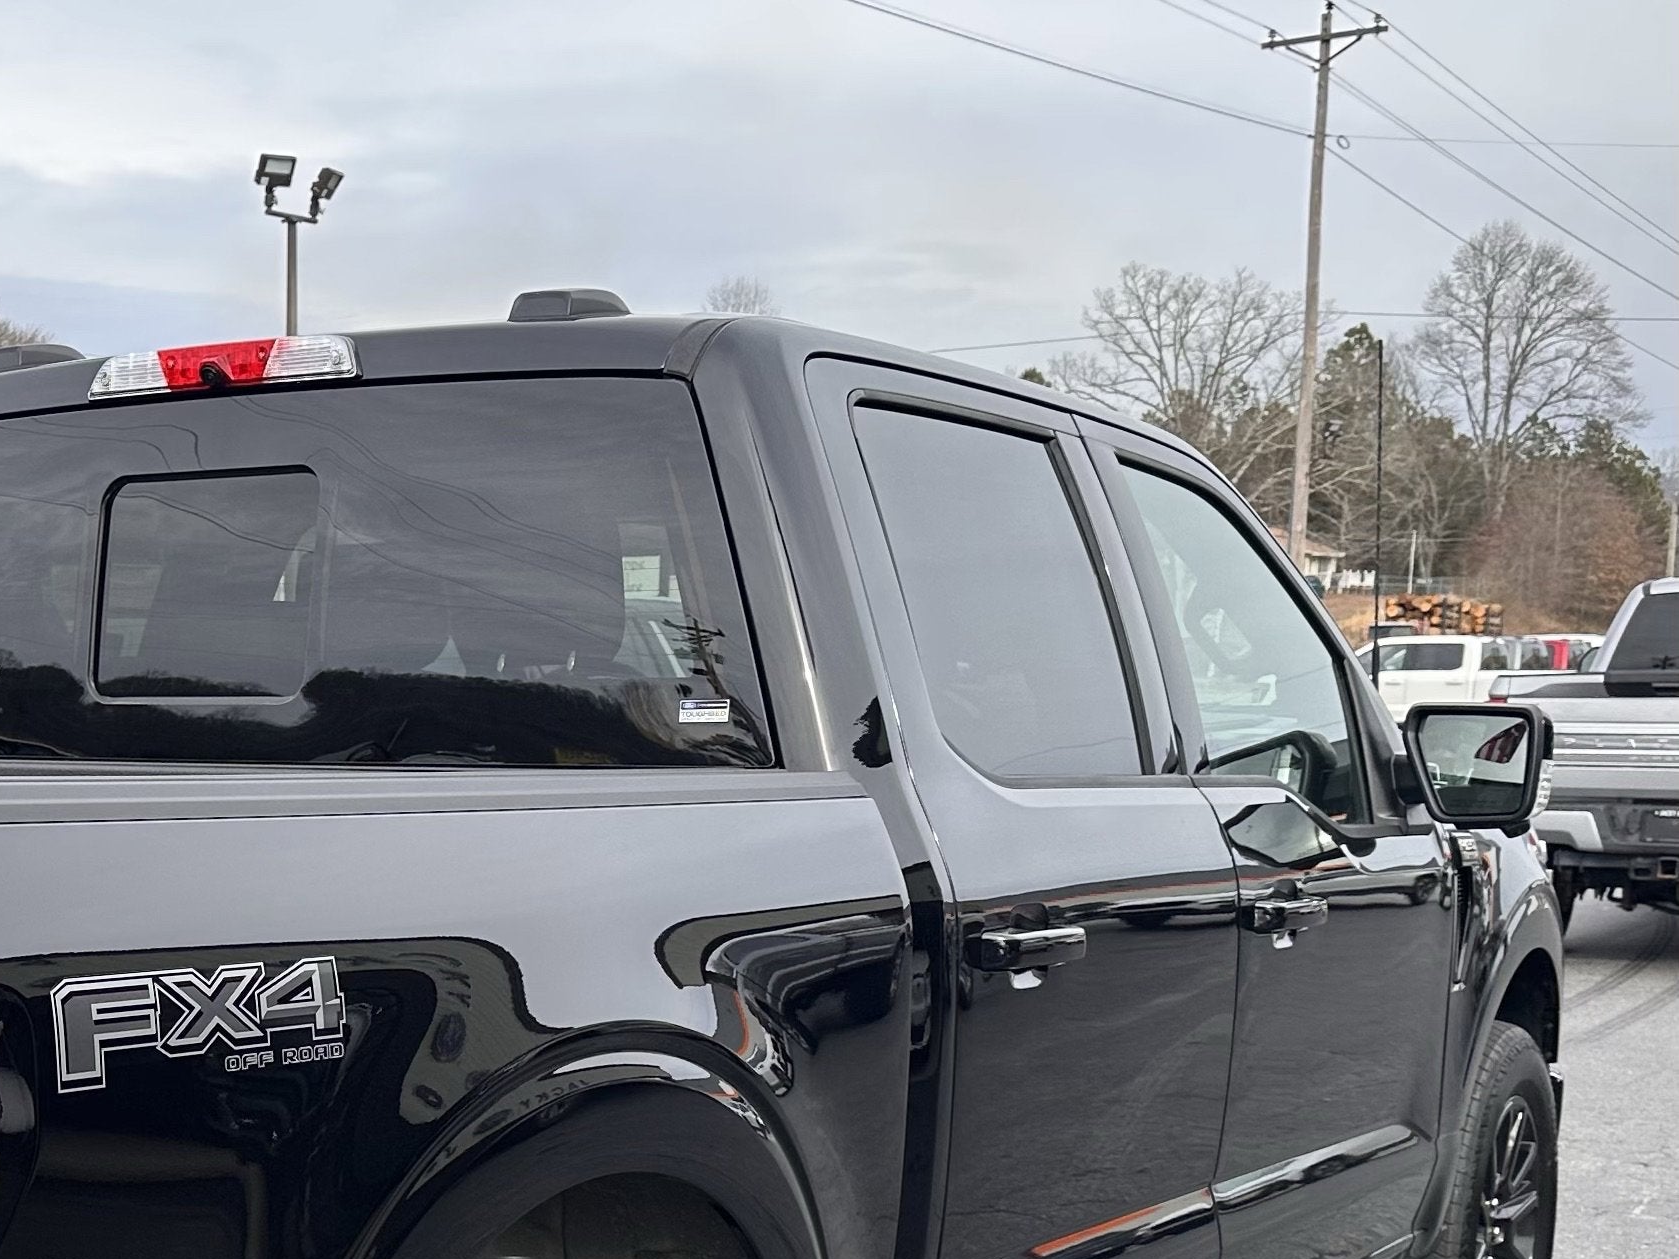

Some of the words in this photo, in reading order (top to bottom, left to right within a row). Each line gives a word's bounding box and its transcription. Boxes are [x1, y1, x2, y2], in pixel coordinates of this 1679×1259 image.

[50, 955, 347, 1093] FX4
[225, 1053, 275, 1073] OFF
[282, 1041, 346, 1066] ROAD
